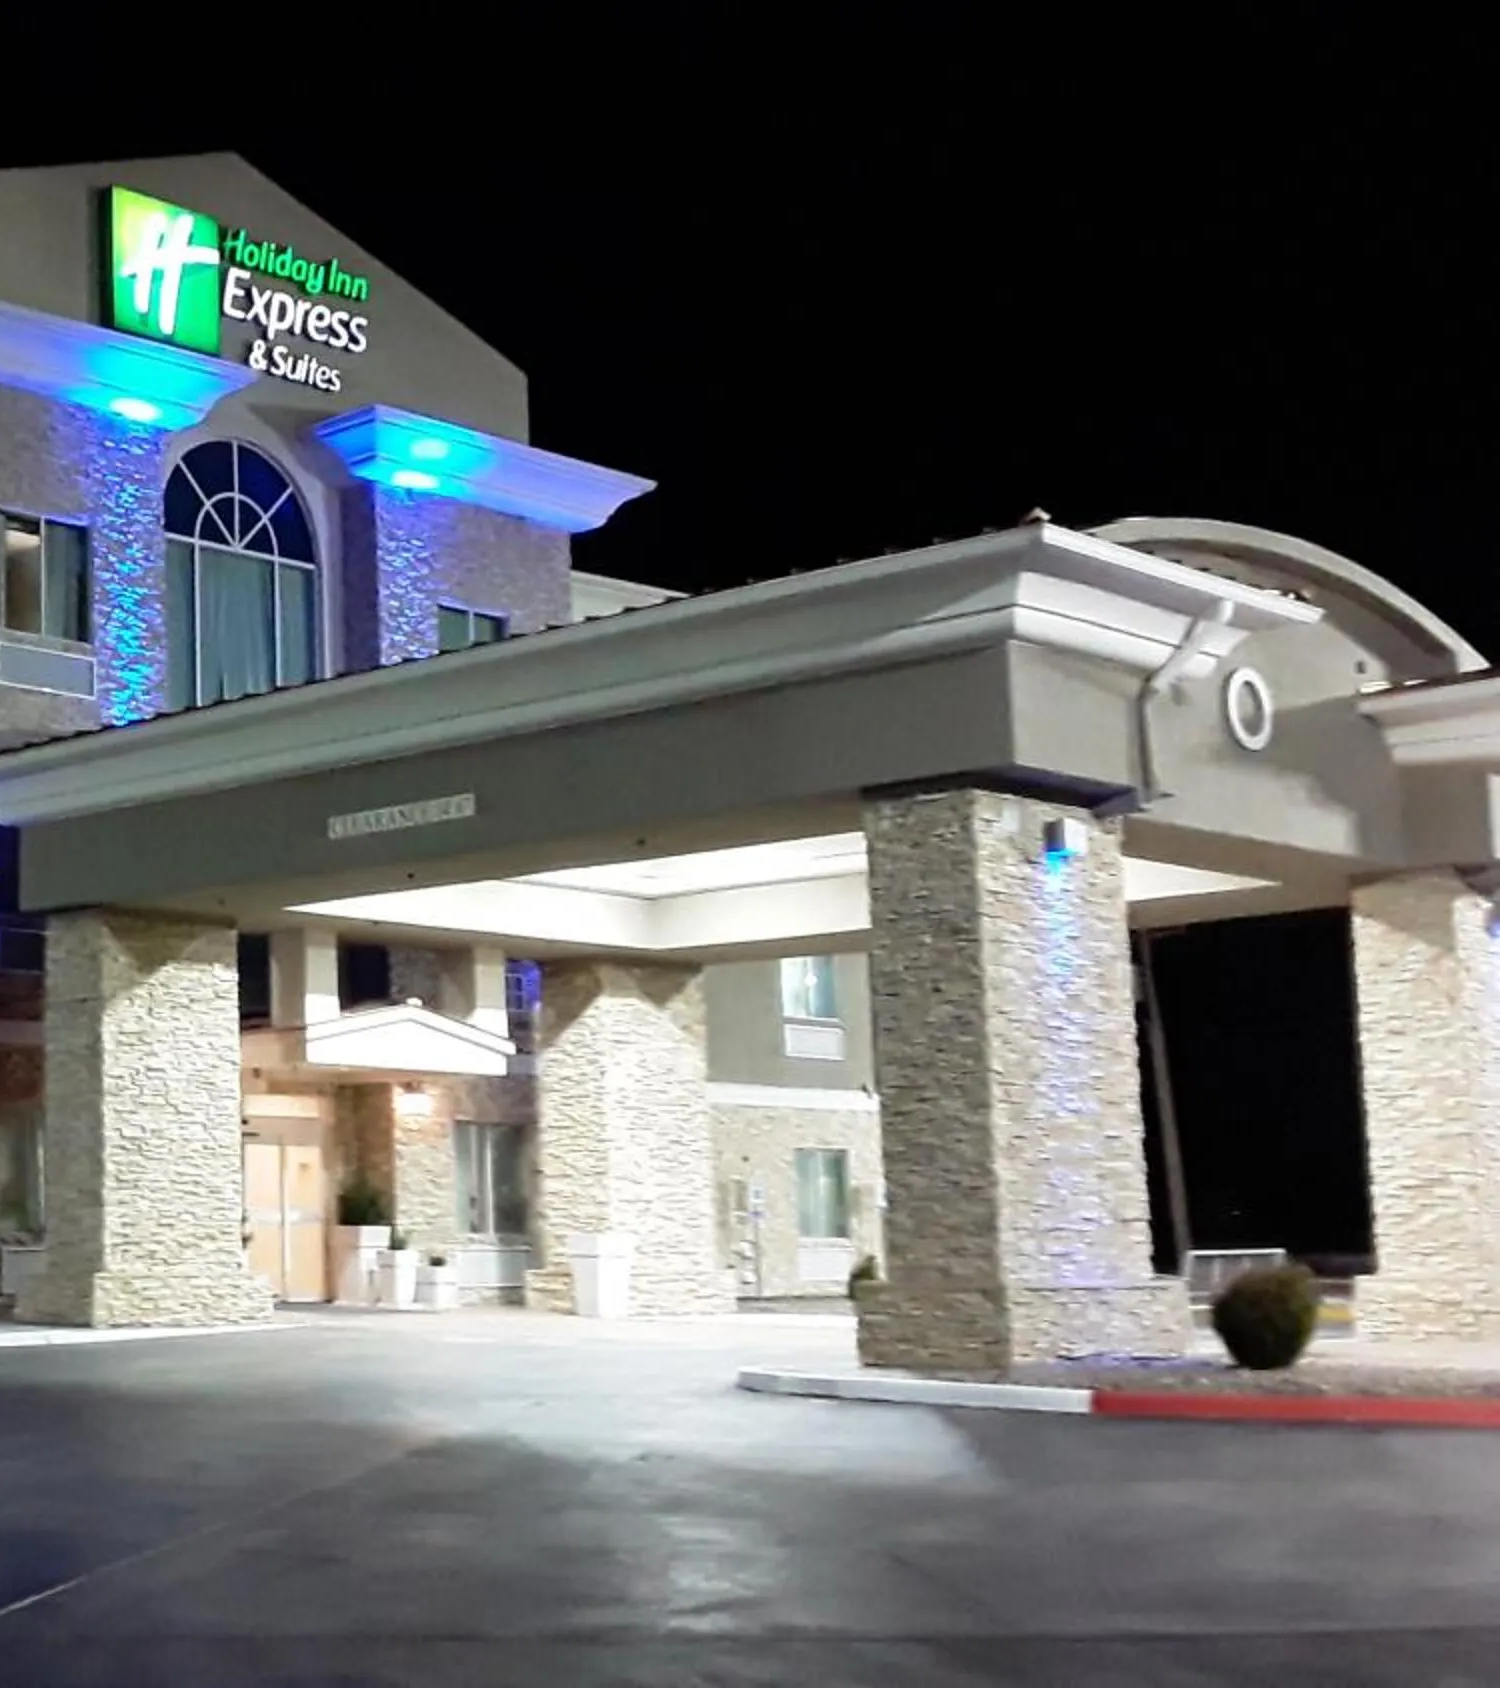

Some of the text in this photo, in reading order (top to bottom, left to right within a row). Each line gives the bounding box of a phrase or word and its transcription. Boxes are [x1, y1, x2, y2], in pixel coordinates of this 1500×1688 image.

[223, 229, 369, 301] Holiday Inn
[222, 267, 368, 353] Express
[248, 340, 342, 392] & Suites
